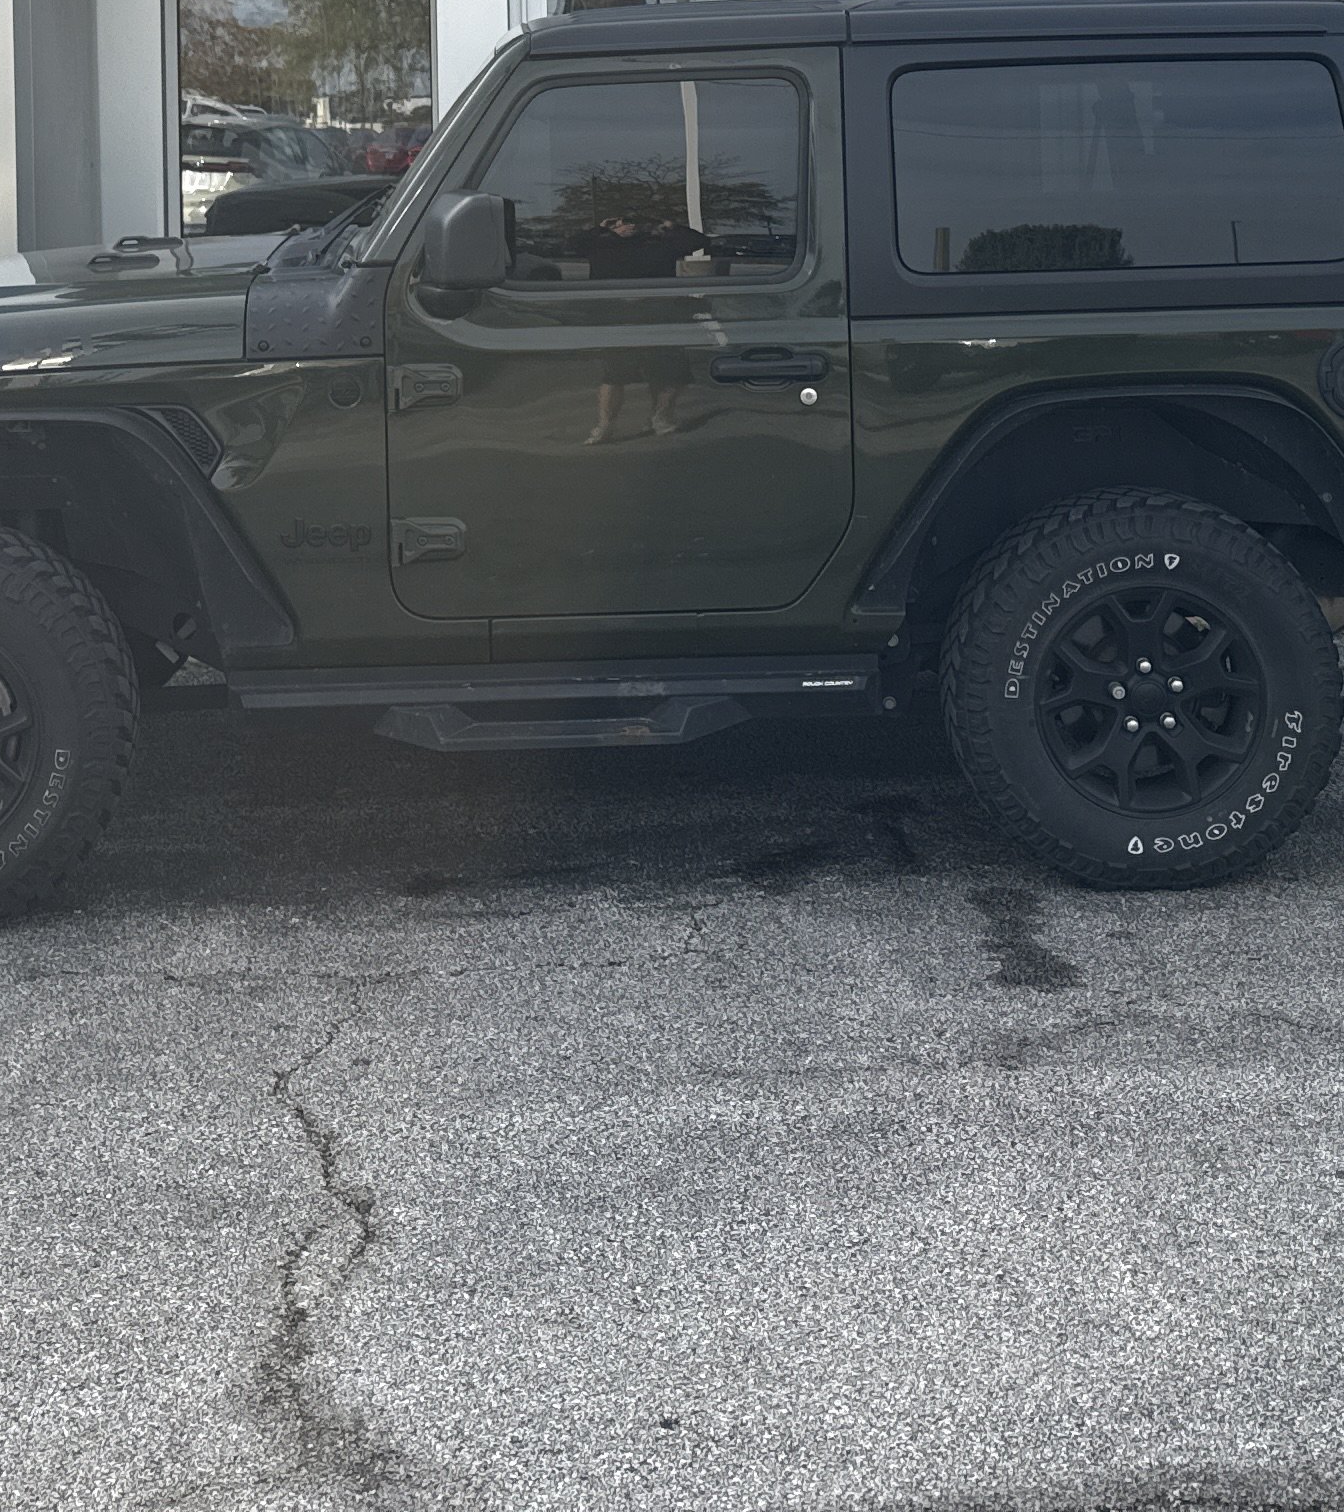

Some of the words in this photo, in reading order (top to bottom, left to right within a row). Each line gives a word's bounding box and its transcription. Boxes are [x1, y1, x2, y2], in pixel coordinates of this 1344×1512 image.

[280, 517, 372, 552] Jeep
[1005, 553, 1154, 699] DESTINATION
[1154, 710, 1303, 853] Firestone
